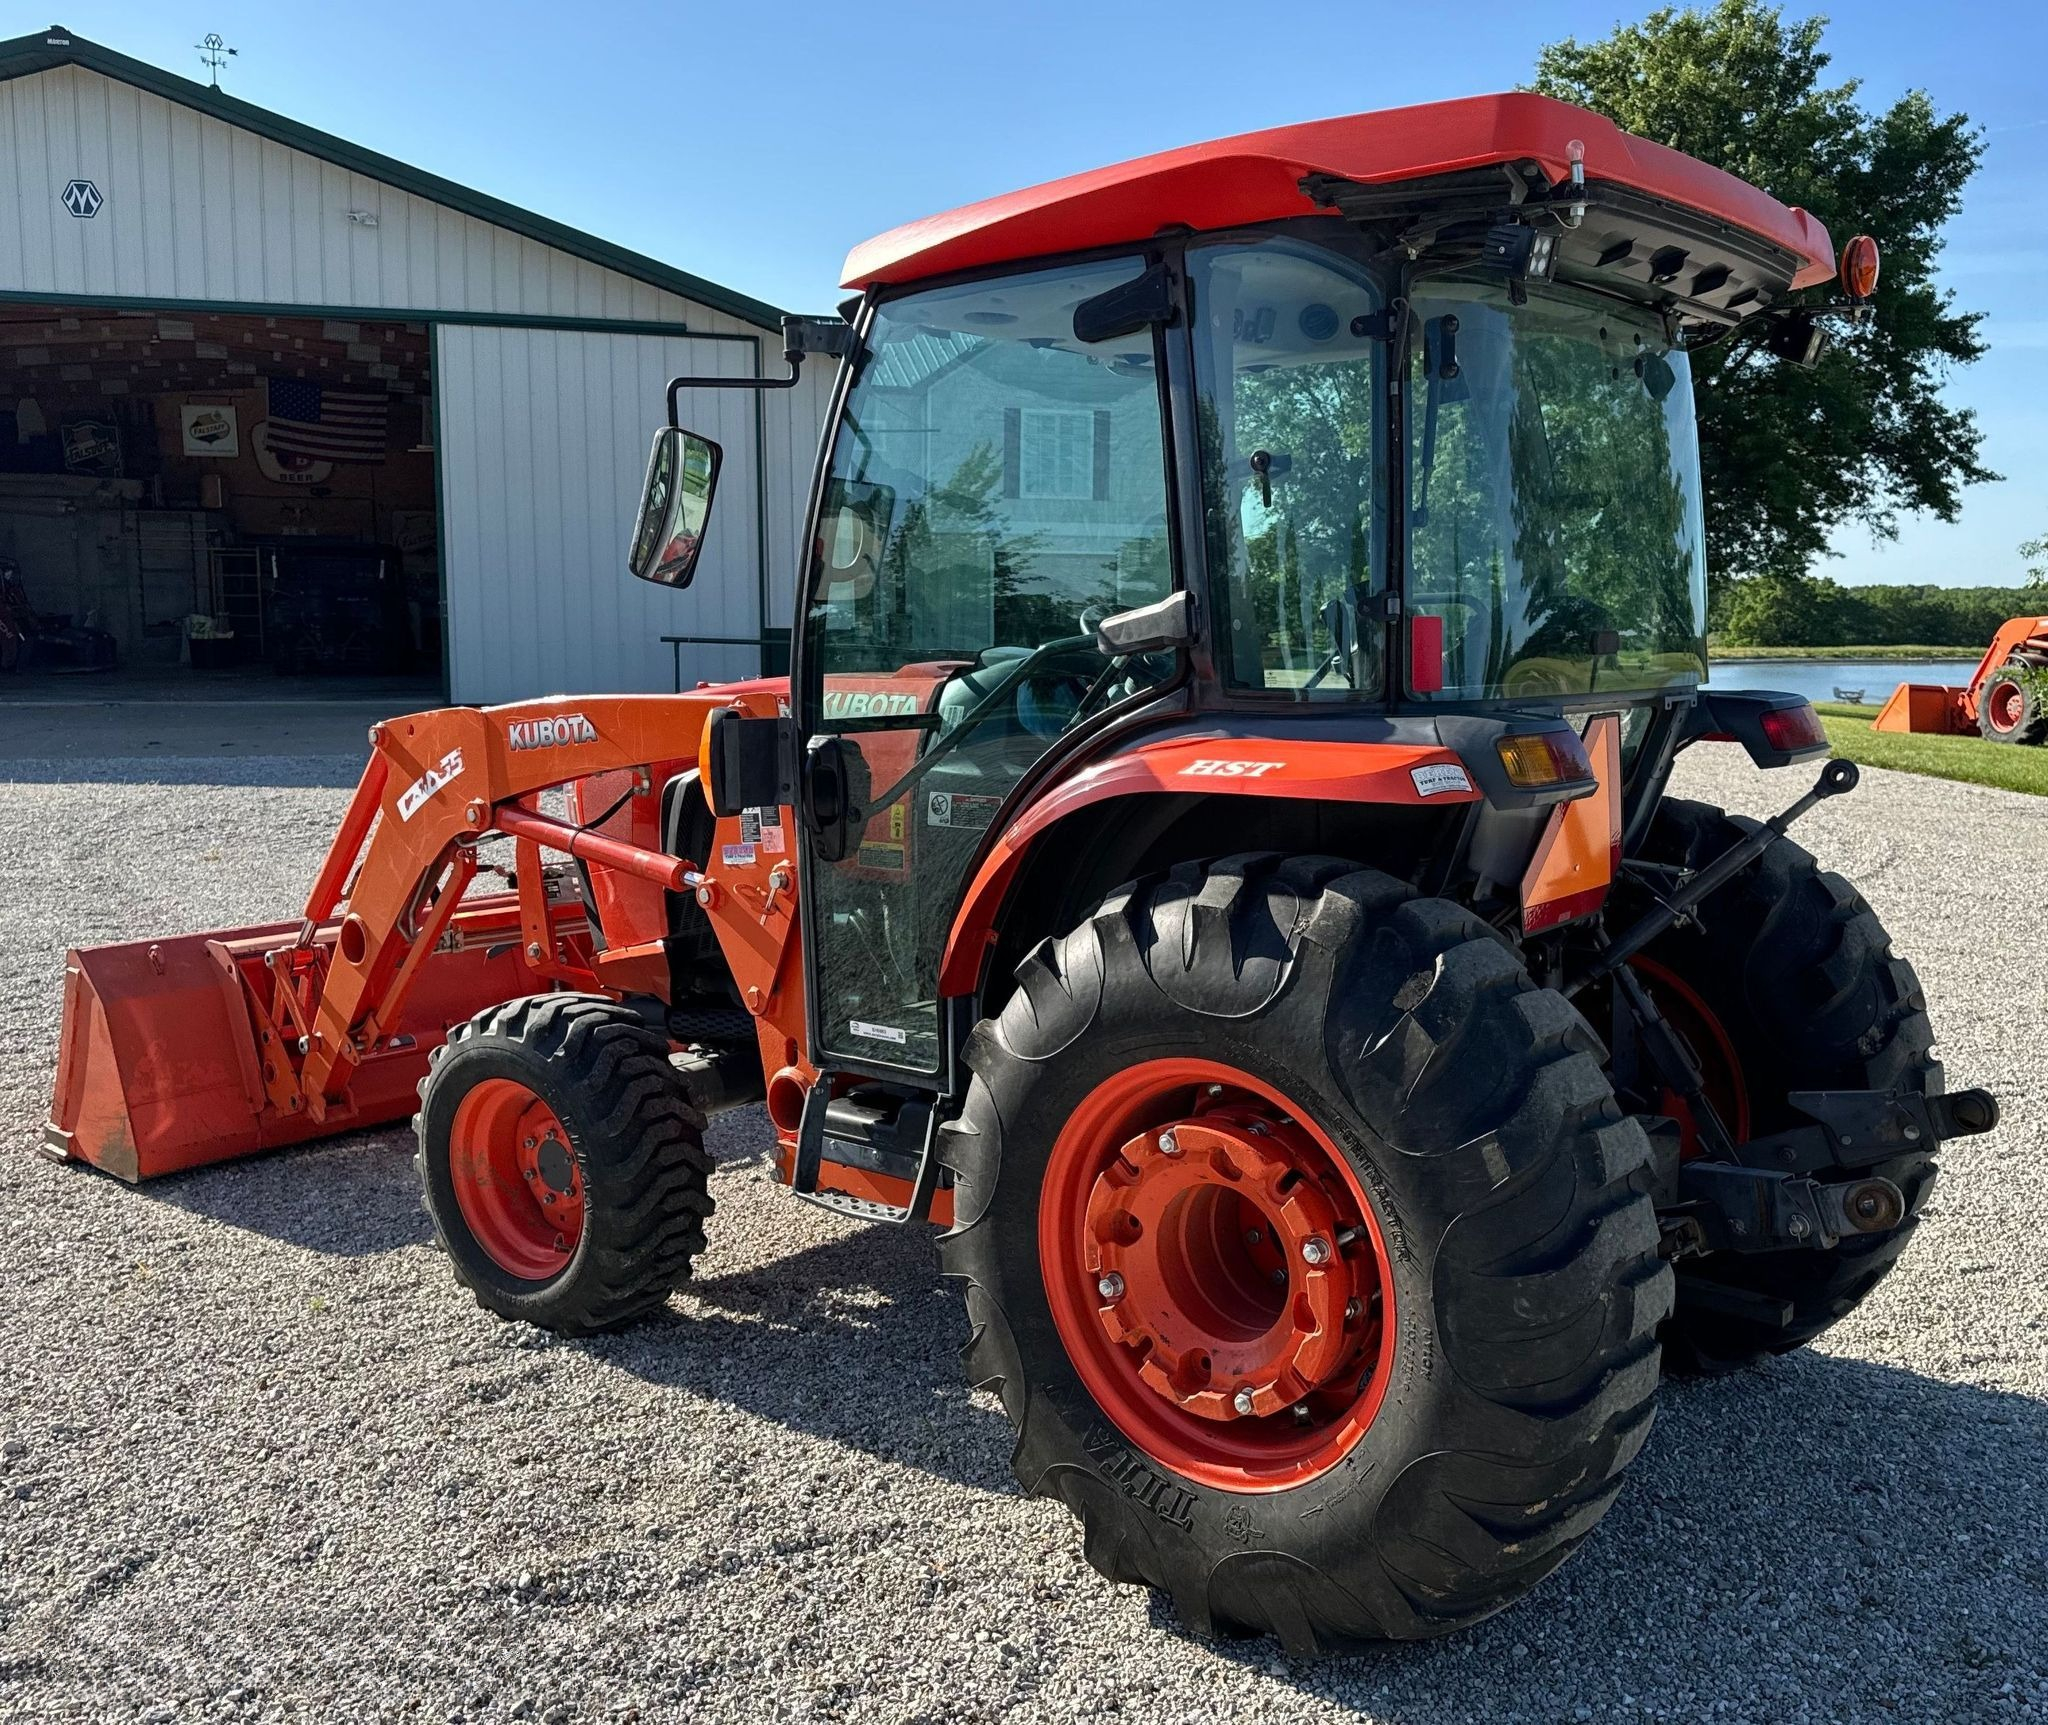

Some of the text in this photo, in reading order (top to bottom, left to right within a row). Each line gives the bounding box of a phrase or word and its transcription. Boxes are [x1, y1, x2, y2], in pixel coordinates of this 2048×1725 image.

[193, 423, 225, 436] FALSTAFF
[279, 473, 313, 482] BEER
[508, 714, 598, 751] KUBOTA
[1177, 759, 1287, 778] HST
[1421, 1327, 1434, 1382] NYLON
